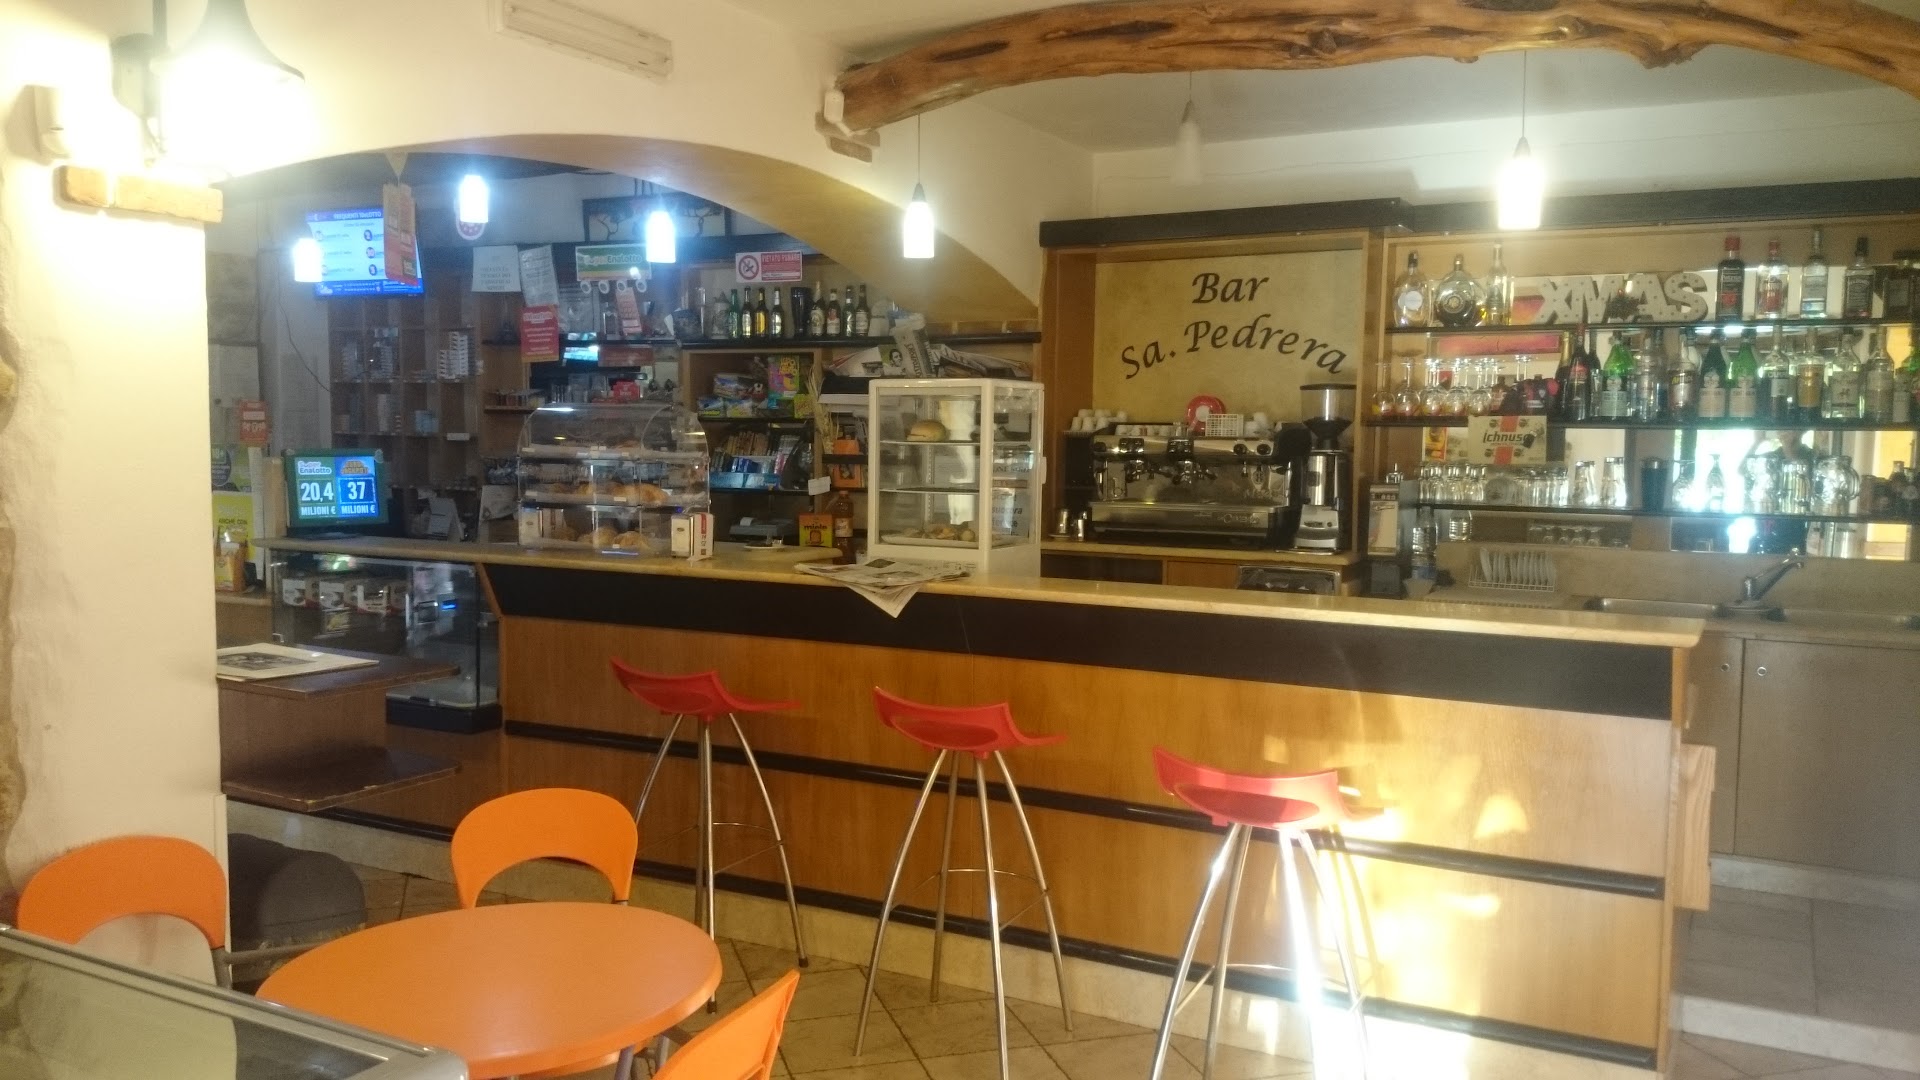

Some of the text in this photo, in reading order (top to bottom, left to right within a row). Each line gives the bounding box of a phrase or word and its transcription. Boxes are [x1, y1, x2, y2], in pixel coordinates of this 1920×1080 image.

[1192, 272, 1270, 304] Bar
[1533, 272, 1710, 325] XMAS
[1121, 313, 1347, 381] Sa. Pedrera
[300, 482, 334, 502] 20,4
[347, 481, 366, 500] 37
[301, 505, 330, 516] MILIONI
[341, 504, 369, 514] MILIONI
